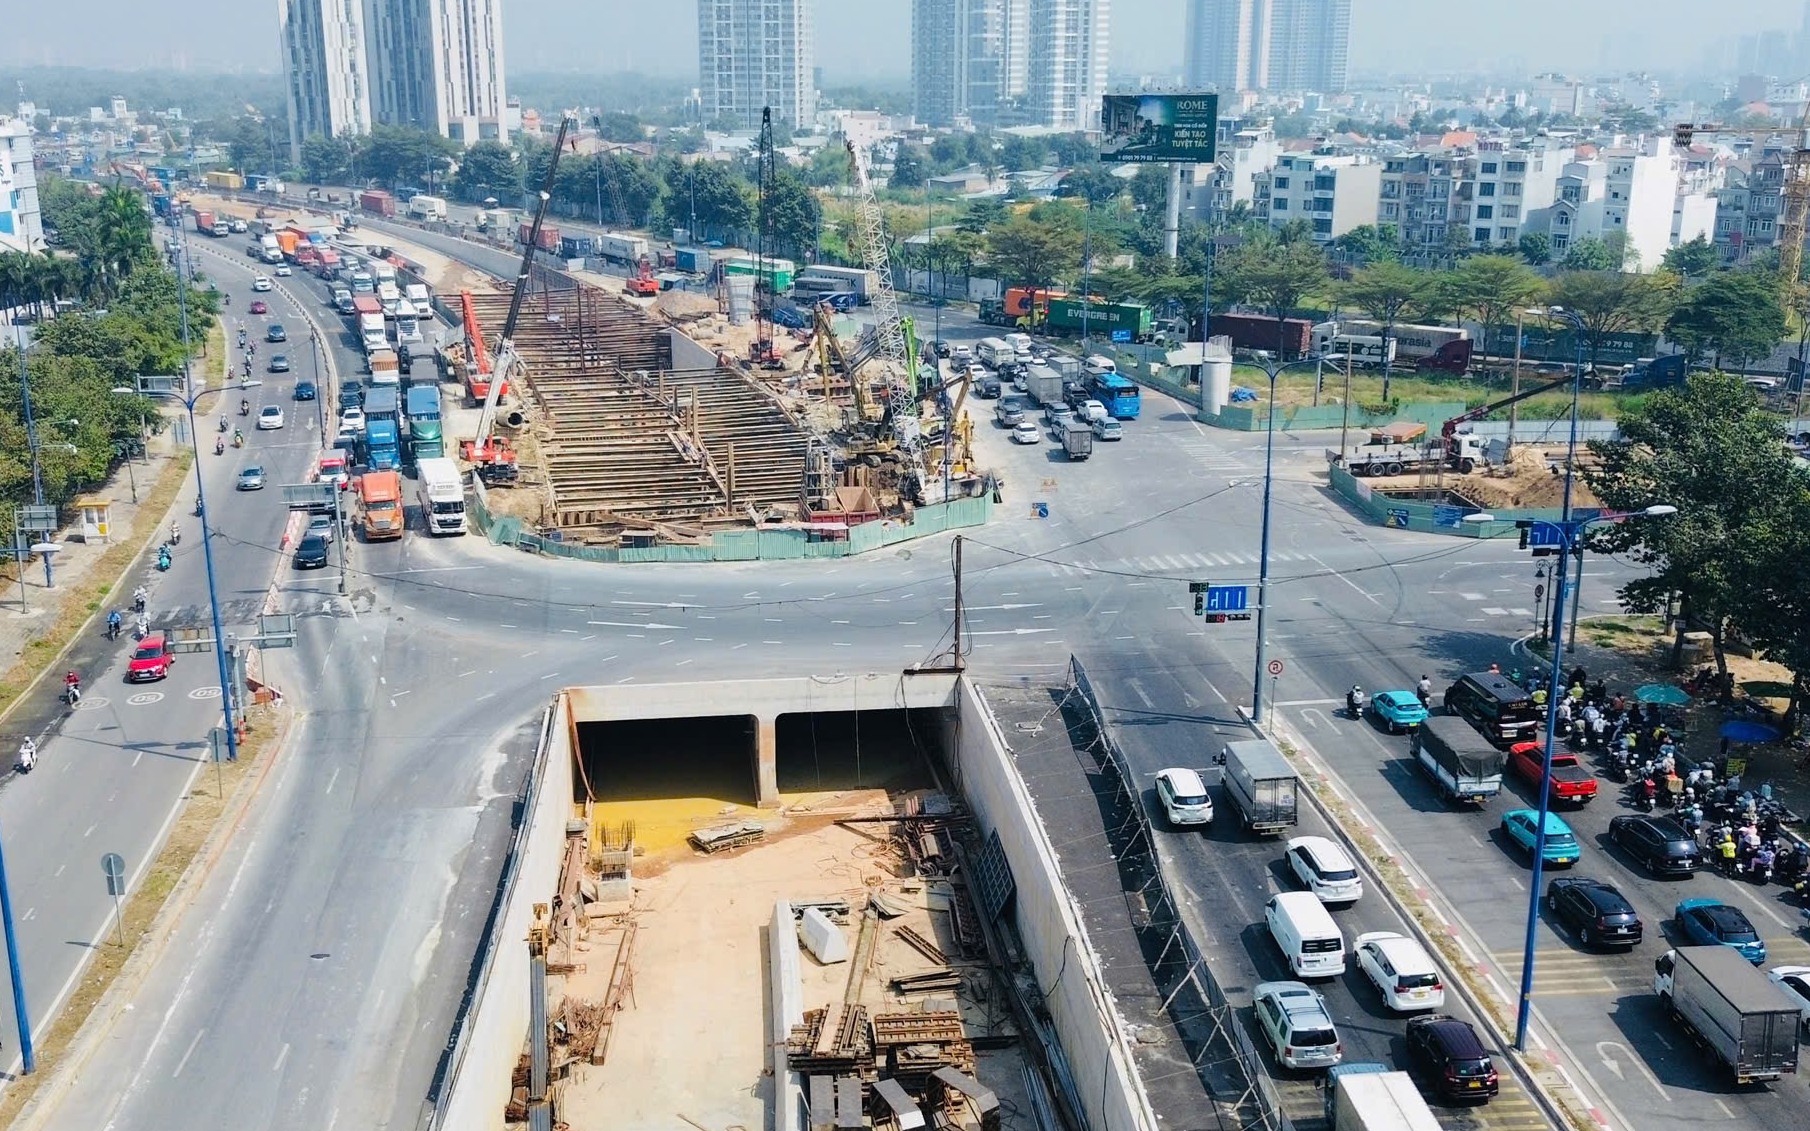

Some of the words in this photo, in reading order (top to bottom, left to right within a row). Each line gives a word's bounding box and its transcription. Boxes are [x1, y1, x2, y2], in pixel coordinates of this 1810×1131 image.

[1176, 100, 1208, 110] ROME
[1067, 308, 1120, 322] EVERGREEN
[1613, 340, 1622, 348] 79
[1624, 341, 1633, 349] 88
